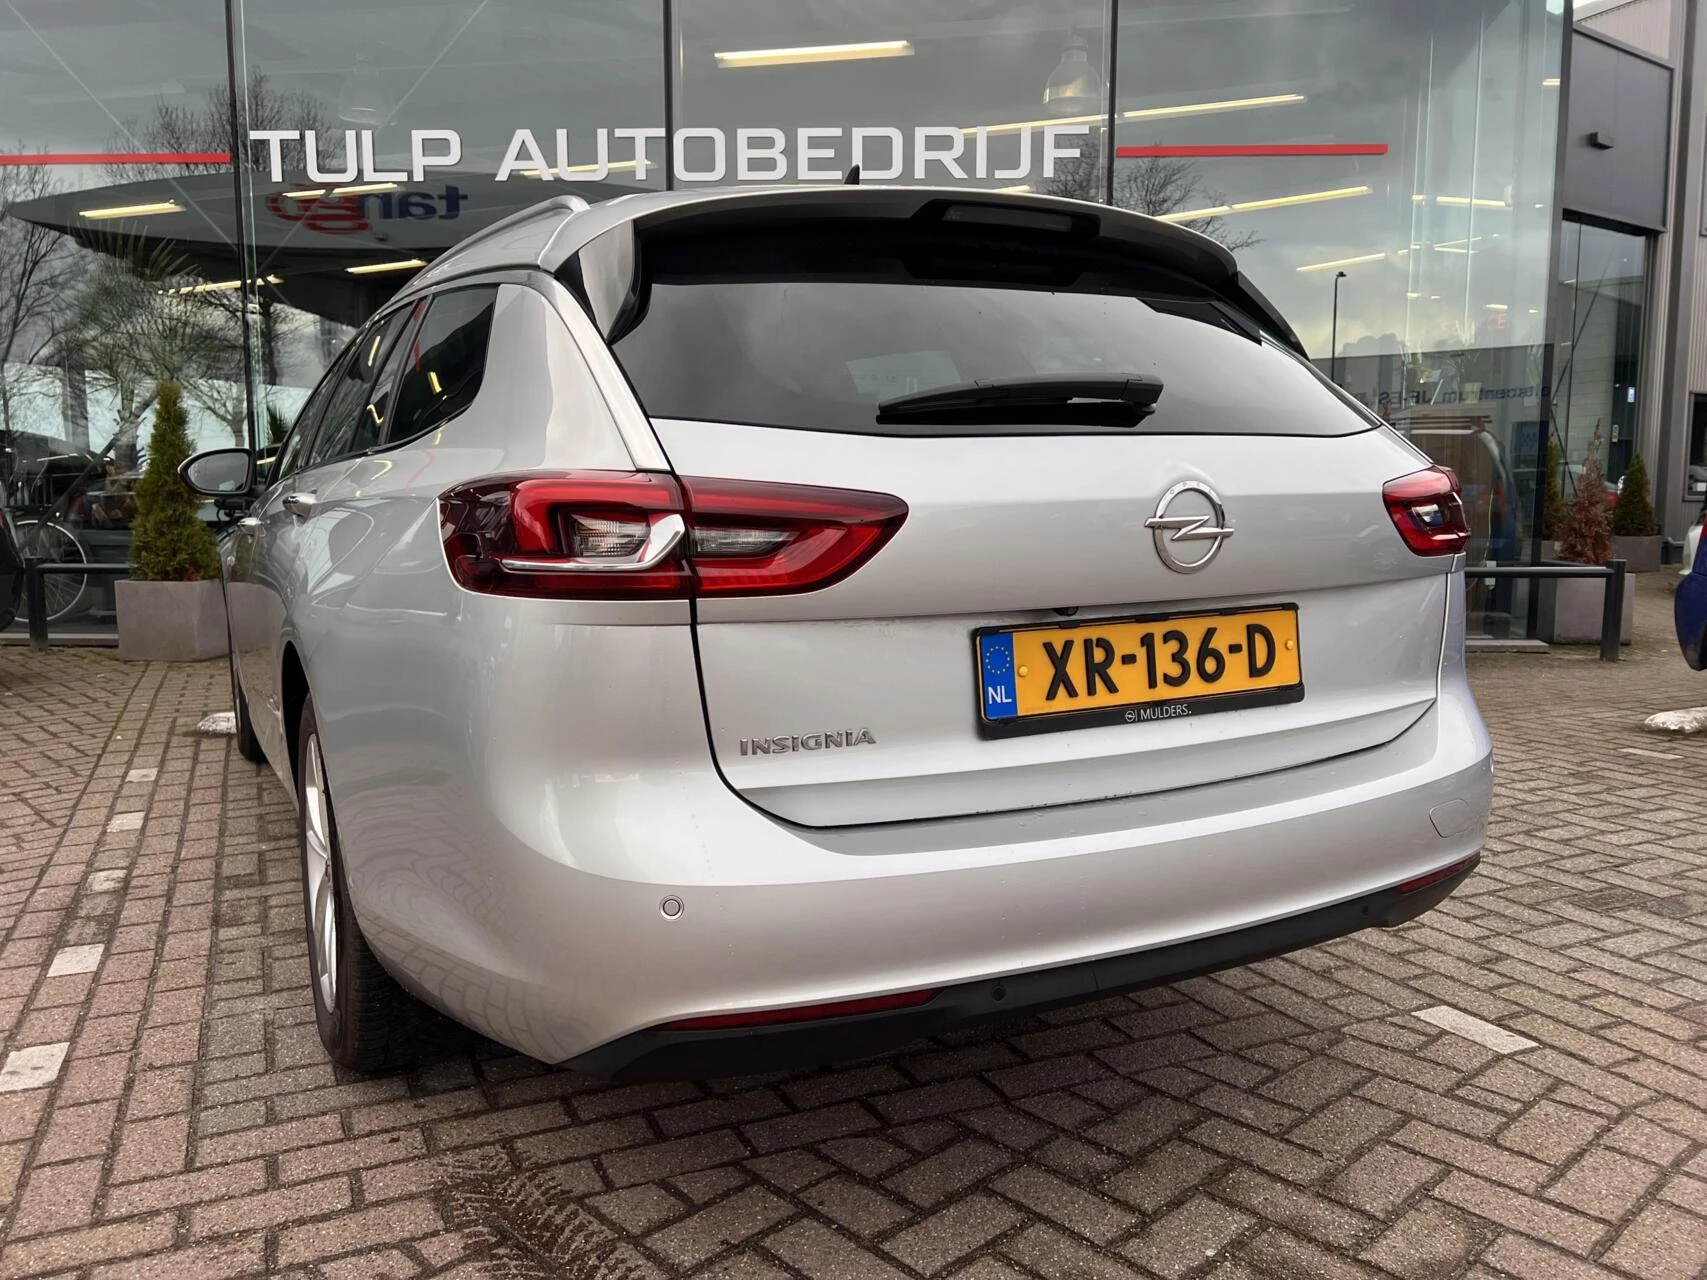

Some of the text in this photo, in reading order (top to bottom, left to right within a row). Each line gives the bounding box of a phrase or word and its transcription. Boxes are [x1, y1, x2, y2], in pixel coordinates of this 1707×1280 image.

[249, 125, 1090, 183] TULP AUTOBEDRIJF
[1042, 624, 1276, 701] XR-136-D
[988, 686, 1012, 704] NL
[739, 728, 877, 756] INSIGNIA
